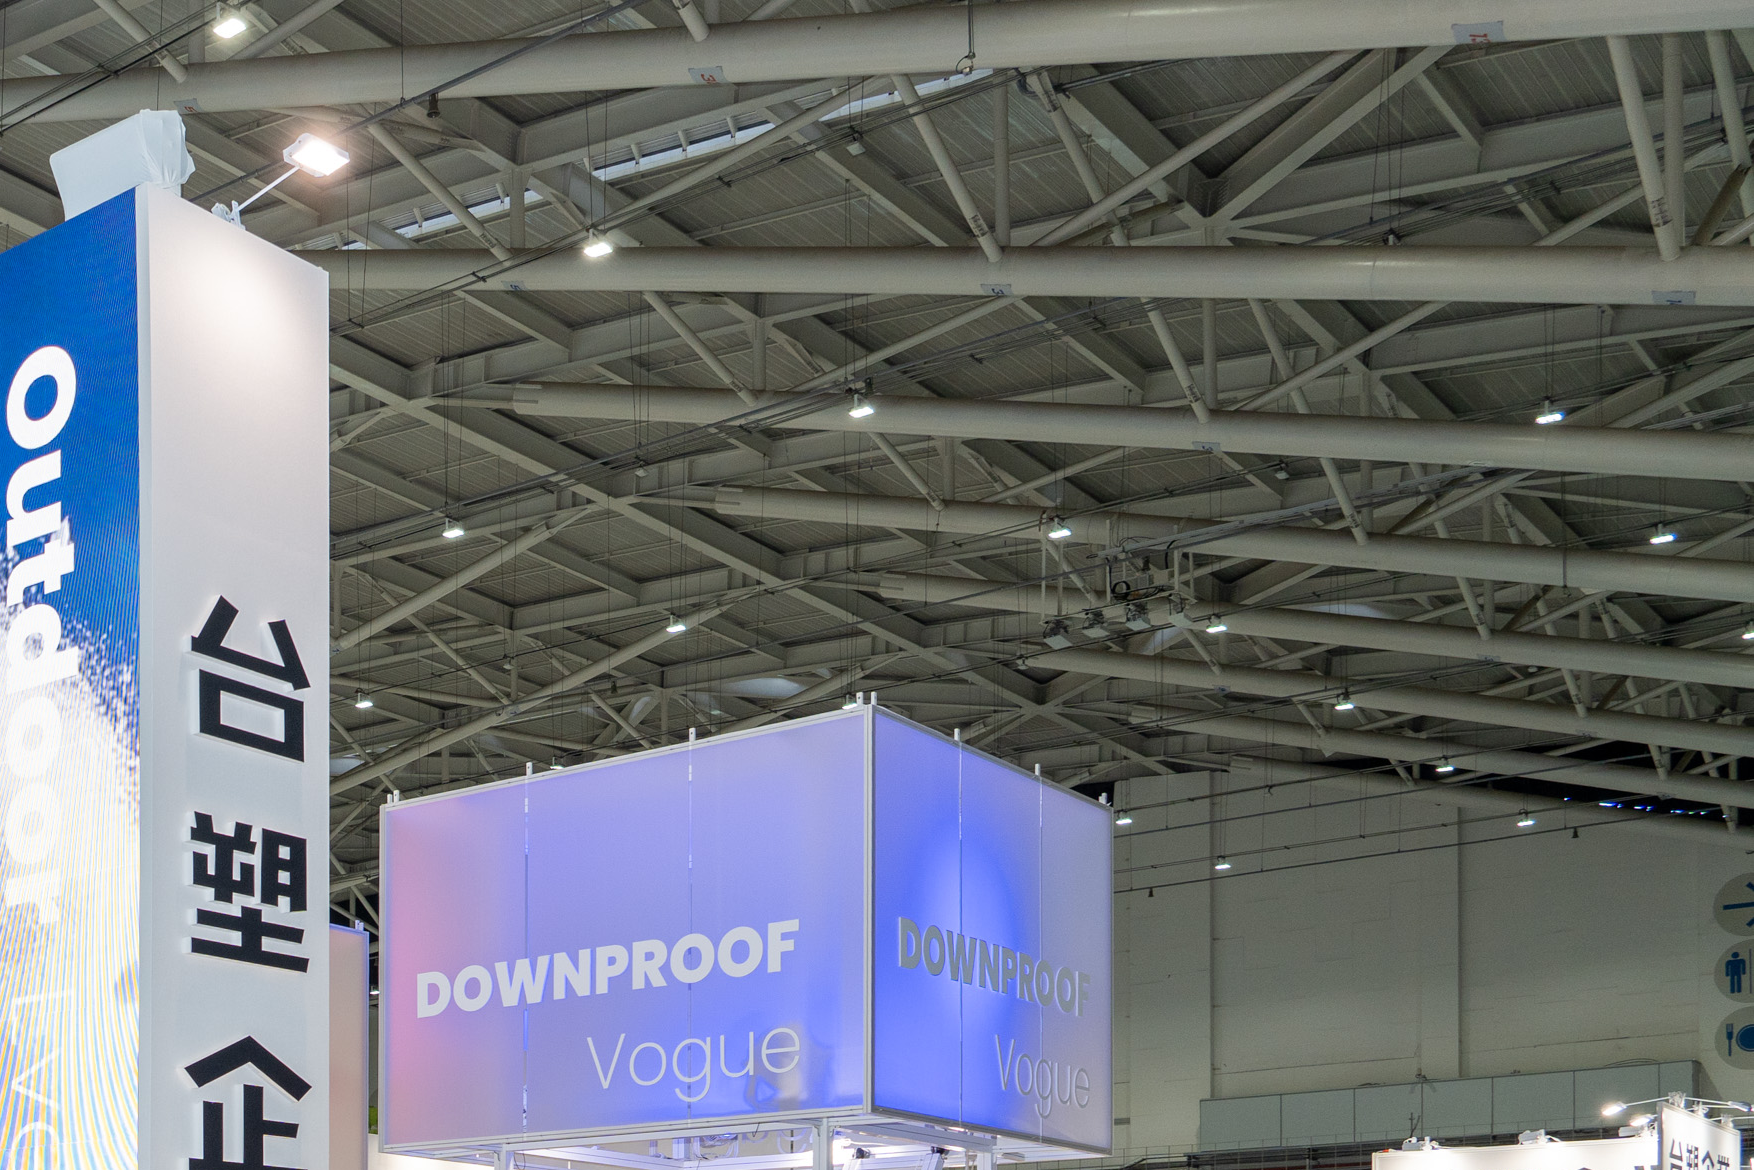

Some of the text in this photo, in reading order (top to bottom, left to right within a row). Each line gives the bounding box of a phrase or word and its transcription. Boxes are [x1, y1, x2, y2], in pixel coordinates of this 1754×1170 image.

[6, 346, 79, 924] Outdoor
[416, 918, 800, 1019] DOWNPROOF
[897, 915, 1091, 1018] DOWNPROOF
[586, 1025, 801, 1103] Vogue
[995, 1033, 1091, 1119] Vogue
